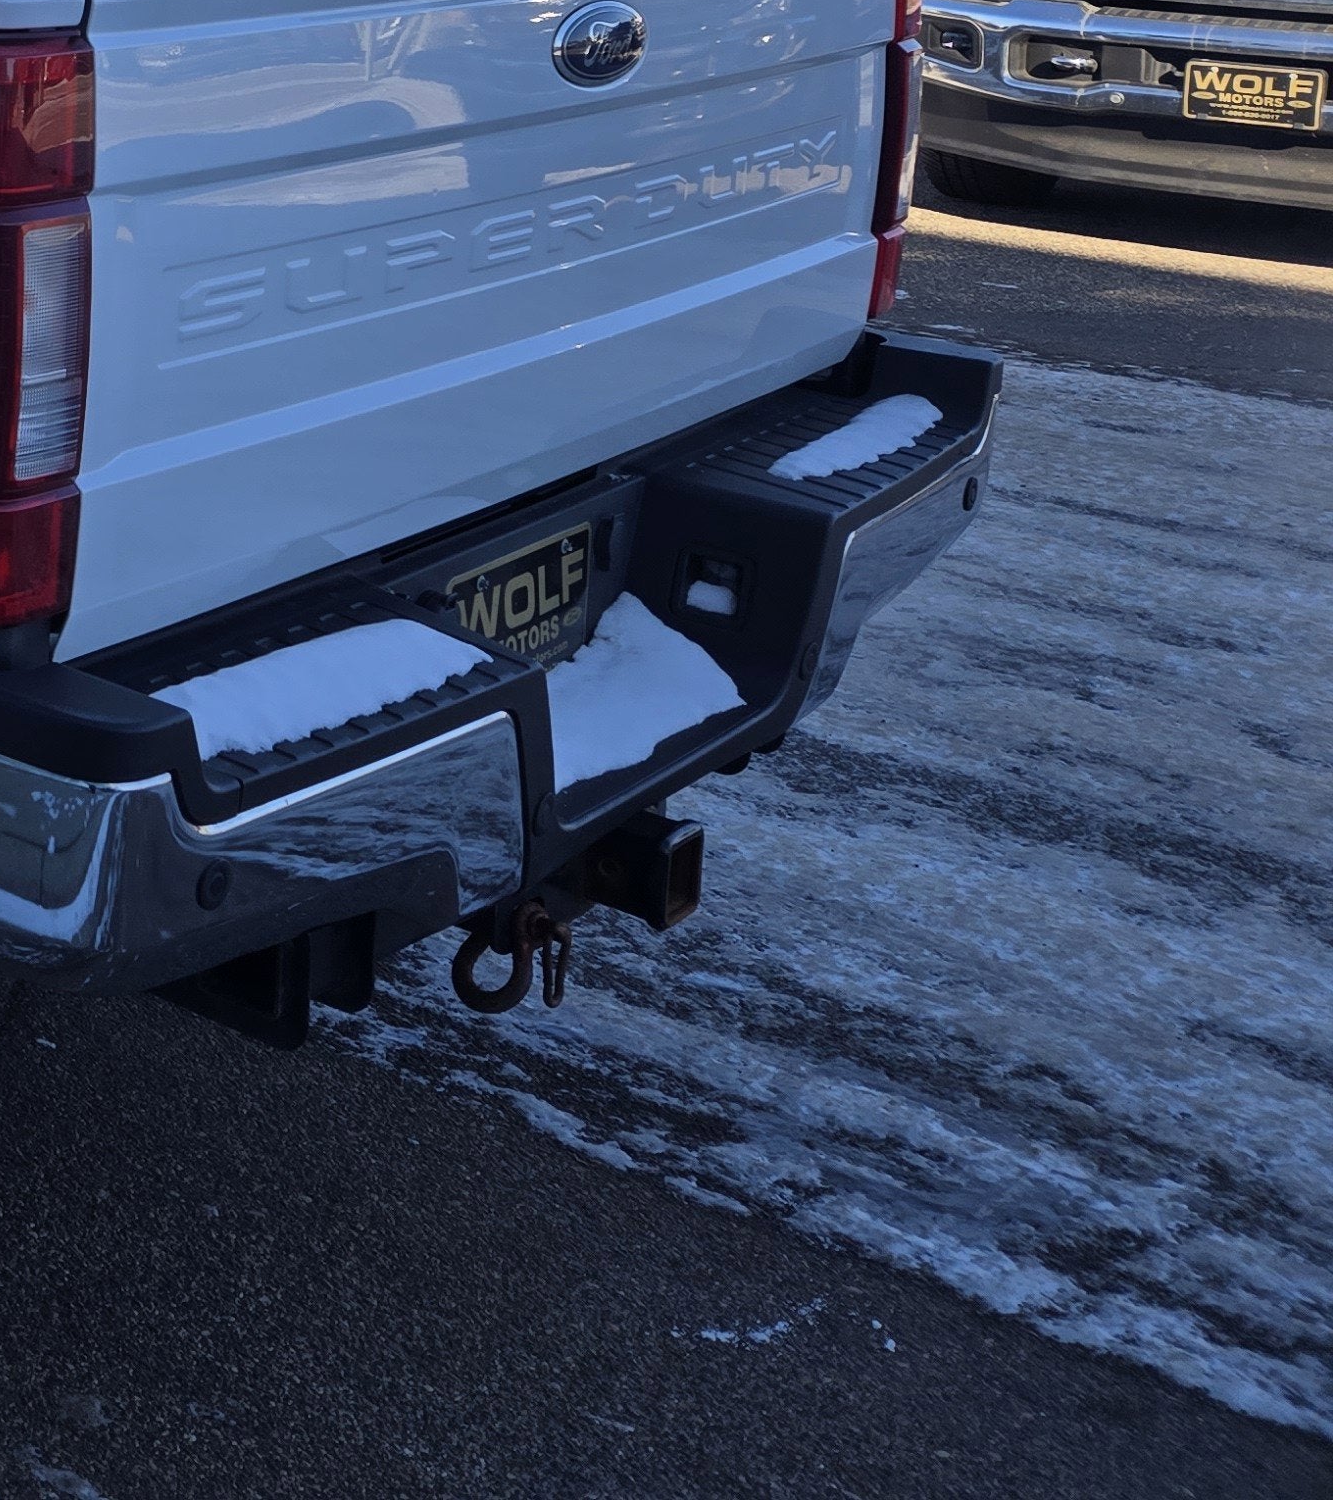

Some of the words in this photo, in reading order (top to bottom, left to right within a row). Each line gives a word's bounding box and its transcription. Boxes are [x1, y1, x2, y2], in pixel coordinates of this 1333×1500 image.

[583, 20, 634, 68] Ford
[1193, 69, 1314, 99] WOLF
[1218, 92, 1284, 108] MOTORS
[178, 194, 607, 344] SUPER
[634, 130, 838, 226] DUTY
[457, 548, 585, 639] WOLF
[498, 614, 560, 655] OTORS
